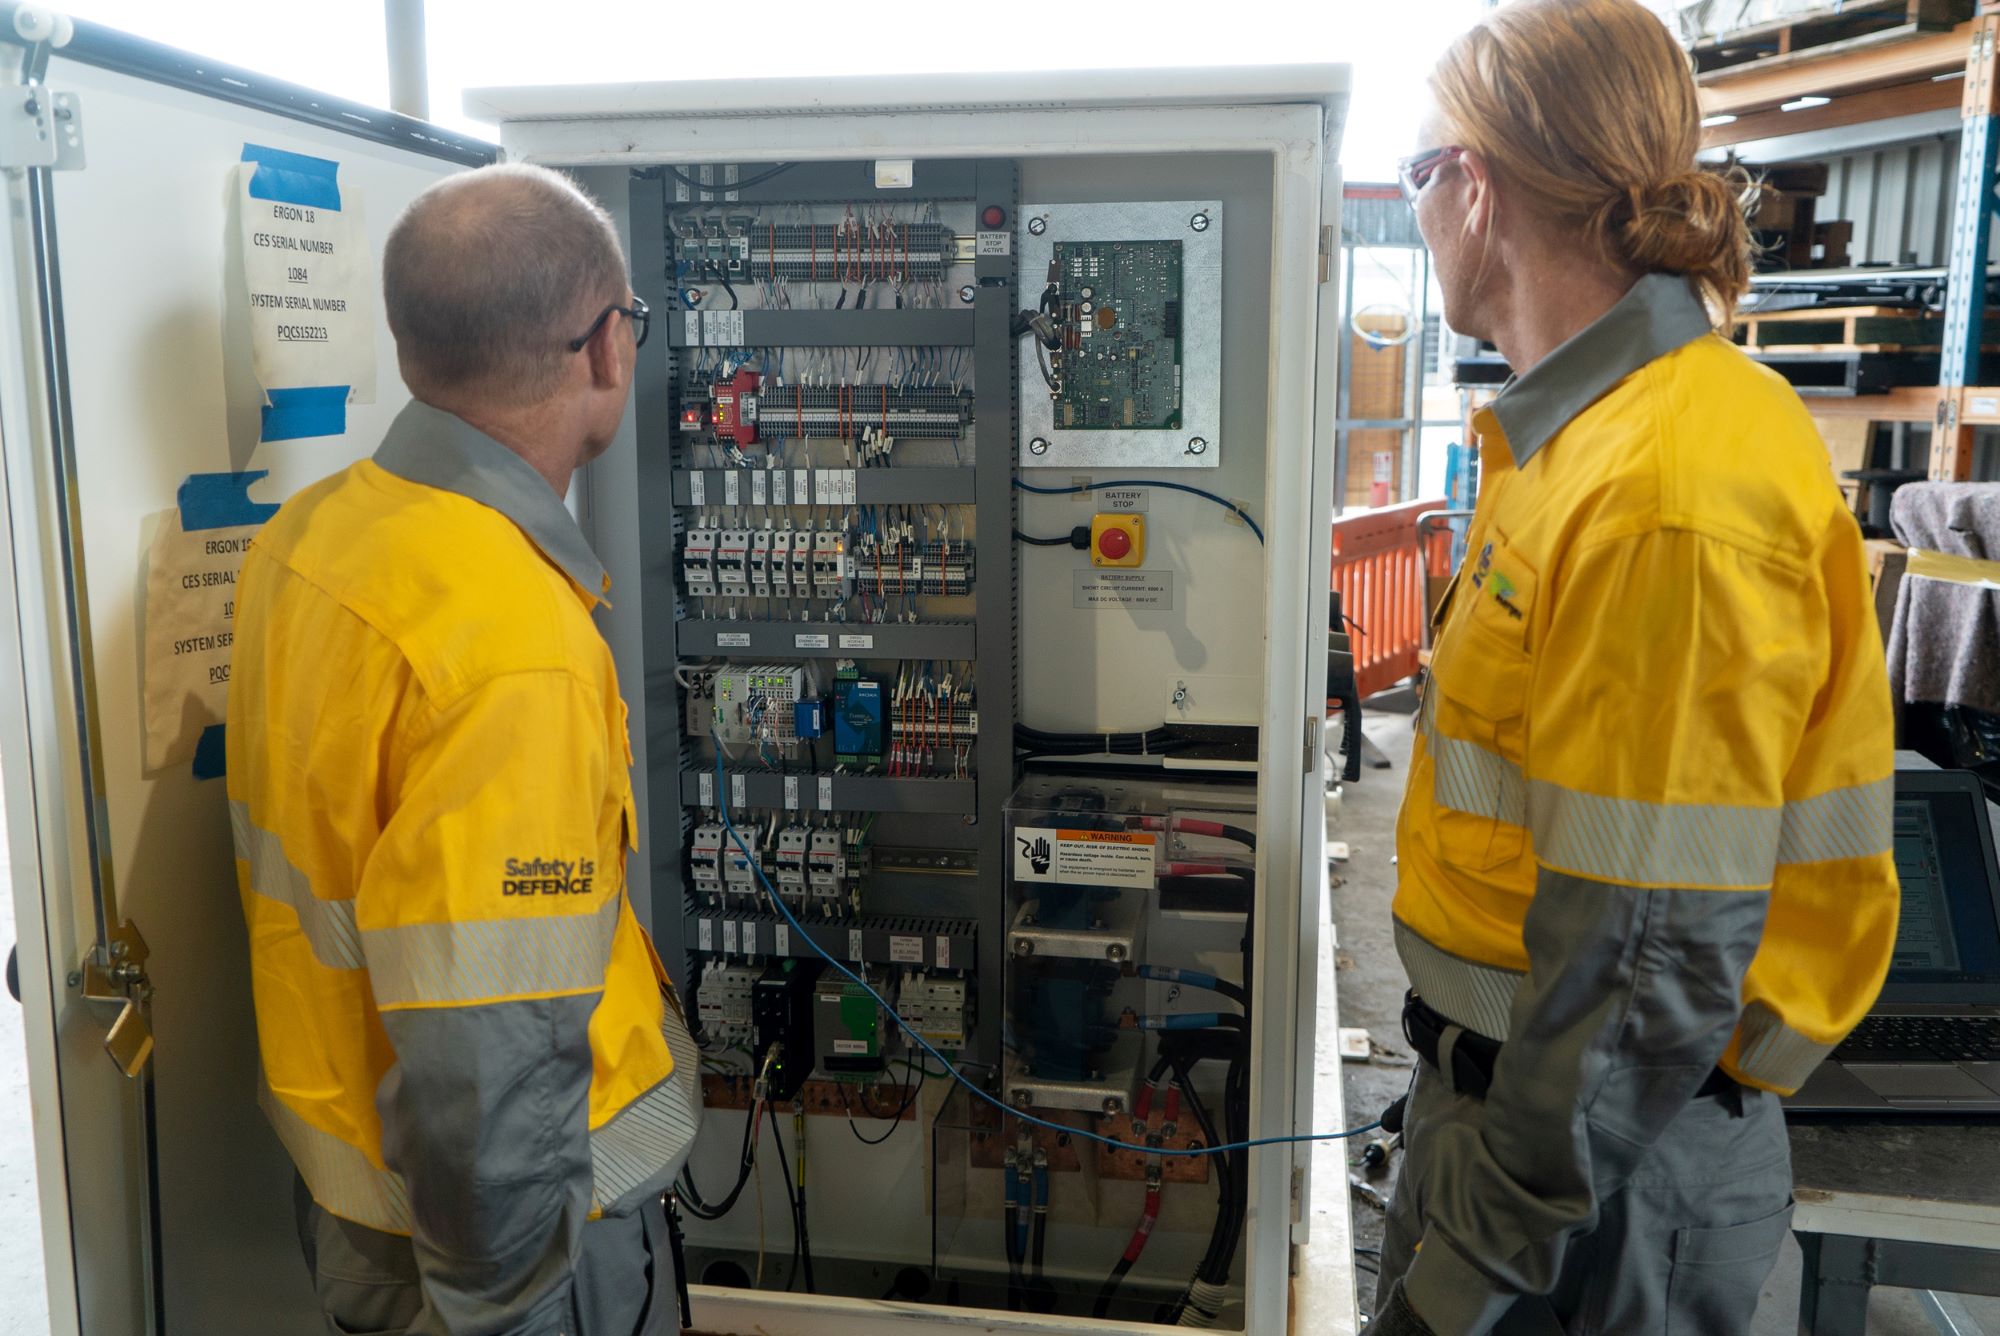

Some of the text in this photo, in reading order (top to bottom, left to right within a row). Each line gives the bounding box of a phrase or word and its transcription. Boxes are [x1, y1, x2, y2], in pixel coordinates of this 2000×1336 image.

[274, 206, 314, 223] ERGON 18
[254, 233, 334, 254] CES SERIAL NUMBER
[288, 267, 308, 280] 1084
[252, 294, 346, 312] SYSTEM SERIAL NUMBER
[278, 326, 328, 340] PQCS152213
[206, 540, 239, 554] ERGON
[182, 570, 235, 589] CES SERIAL
[174, 635, 215, 655] SYSTEM
[1091, 833, 1132, 842] WARNING
[505, 857, 594, 879] Safety is
[503, 878, 592, 896] DEFENCE
